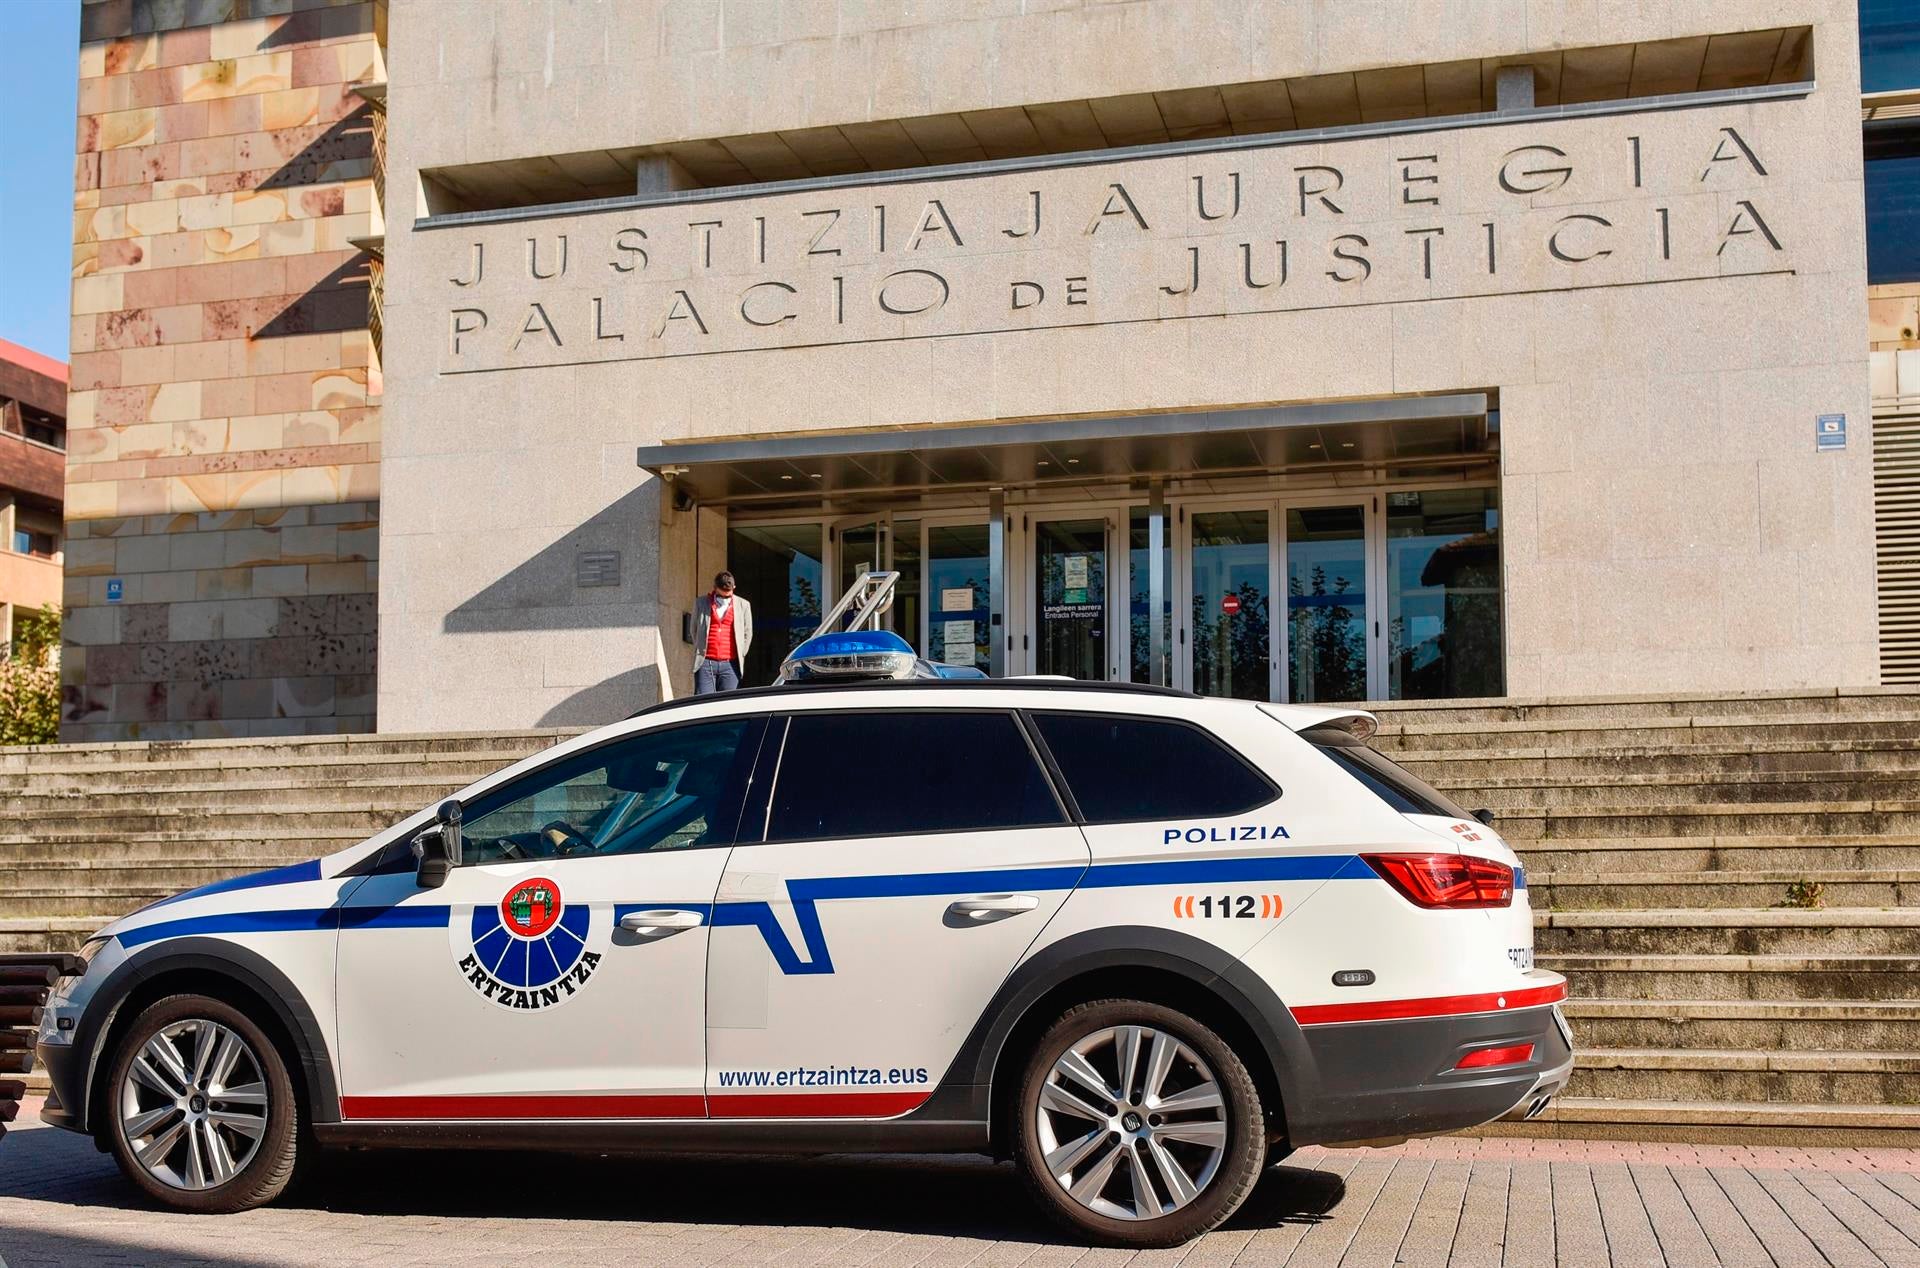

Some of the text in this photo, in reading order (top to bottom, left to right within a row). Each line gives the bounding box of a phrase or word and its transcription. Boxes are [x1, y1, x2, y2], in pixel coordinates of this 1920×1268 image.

[449, 127, 1770, 288] JUSTIZIA JAUREGIA
[449, 200, 1783, 356] PALACIO DE JUSTICIA
[1044, 610, 1099, 619] Entrada Personal
[1164, 826, 1291, 845] POLIZIA
[458, 951, 602, 1010] ERTZAINTZA
[719, 1065, 928, 1087] www.ertzaintza.eus
